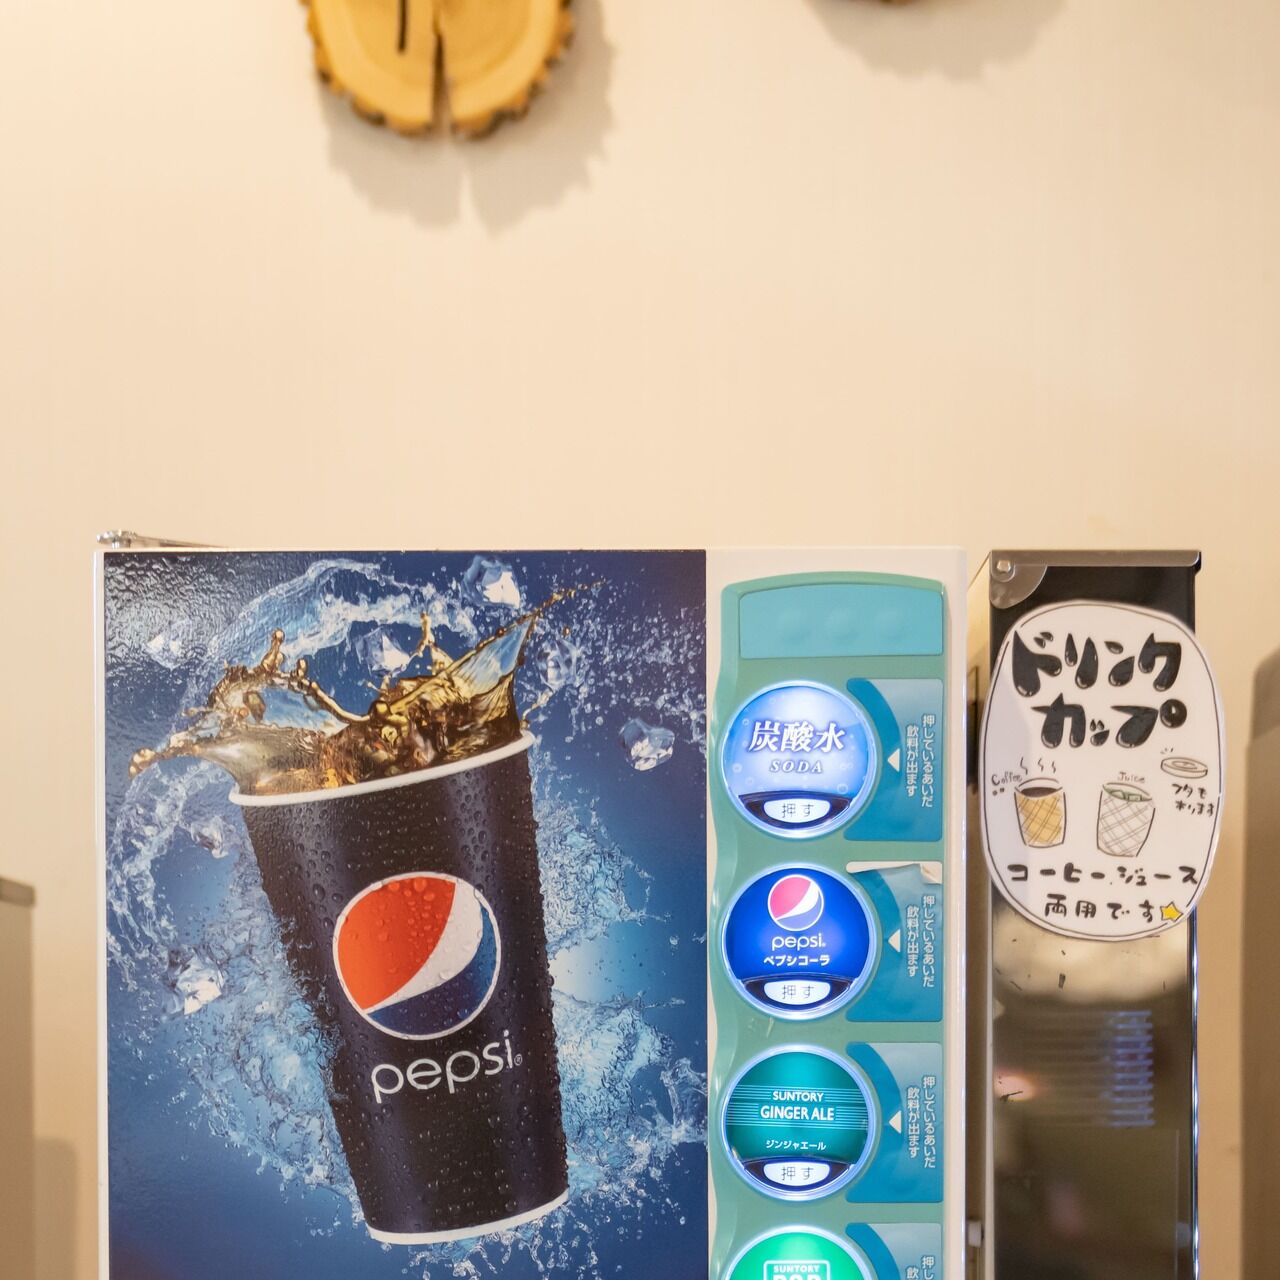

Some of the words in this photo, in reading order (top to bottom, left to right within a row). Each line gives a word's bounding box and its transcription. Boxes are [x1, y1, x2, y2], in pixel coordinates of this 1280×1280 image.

[1012, 630, 1182, 697] ドリンク
[1031, 692, 1187, 748] カップ
[748, 721, 846, 753] 炭酸水
[770, 761, 823, 773] SODA
[906, 725, 919, 797] 飲料が出ます
[921, 714, 936, 808] 押しているあいだ
[781, 803, 814, 818] 押す
[1045, 894, 1154, 923] 両用です
[772, 933, 823, 951] pepsi
[907, 905, 919, 977] 飲料が出ます
[922, 895, 936, 988] 押しているあいだ
[764, 955, 830, 967] ペプシコーラ
[782, 984, 814, 1000] 押す
[371, 1029, 514, 1104] pepsi
[773, 1091, 824, 1103] SUNTORY
[760, 1105, 809, 1120] GINGER
[811, 1107, 835, 1121] ALE
[907, 1087, 920, 1159] 飲料が出ます
[922, 1076, 936, 1168] 押しているあいだ
[766, 1139, 827, 1151] ジンジャエール
[781, 1166, 814, 1181] 押す
[773, 1265, 820, 1273] SUNTORY
